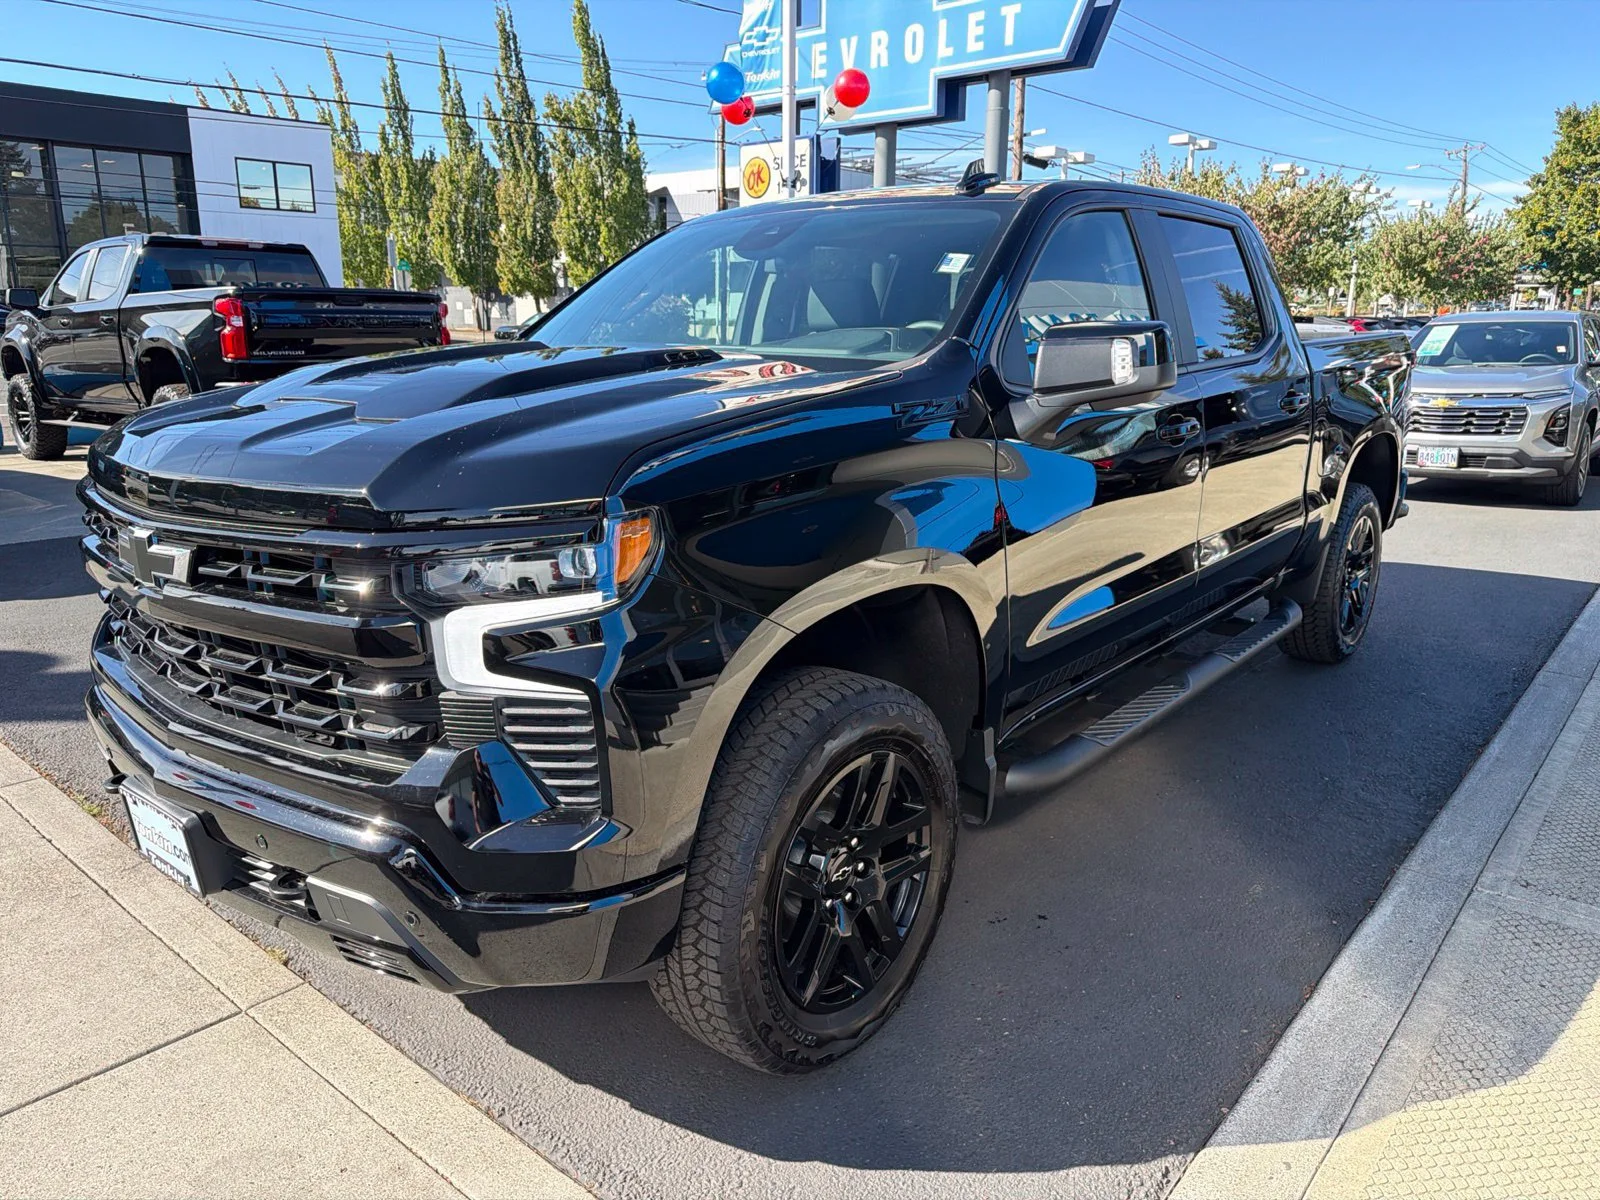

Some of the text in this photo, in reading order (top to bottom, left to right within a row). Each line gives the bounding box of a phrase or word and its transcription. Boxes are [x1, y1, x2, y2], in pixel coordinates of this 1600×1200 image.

[741, 47, 780, 58] CHEVROLET
[797, 5, 1021, 79] EVROLET
[745, 69, 780, 83] Tonkin
[773, 153, 807, 170] SICE
[747, 164, 765, 191] OK
[147, 851, 186, 889] Tonkin
